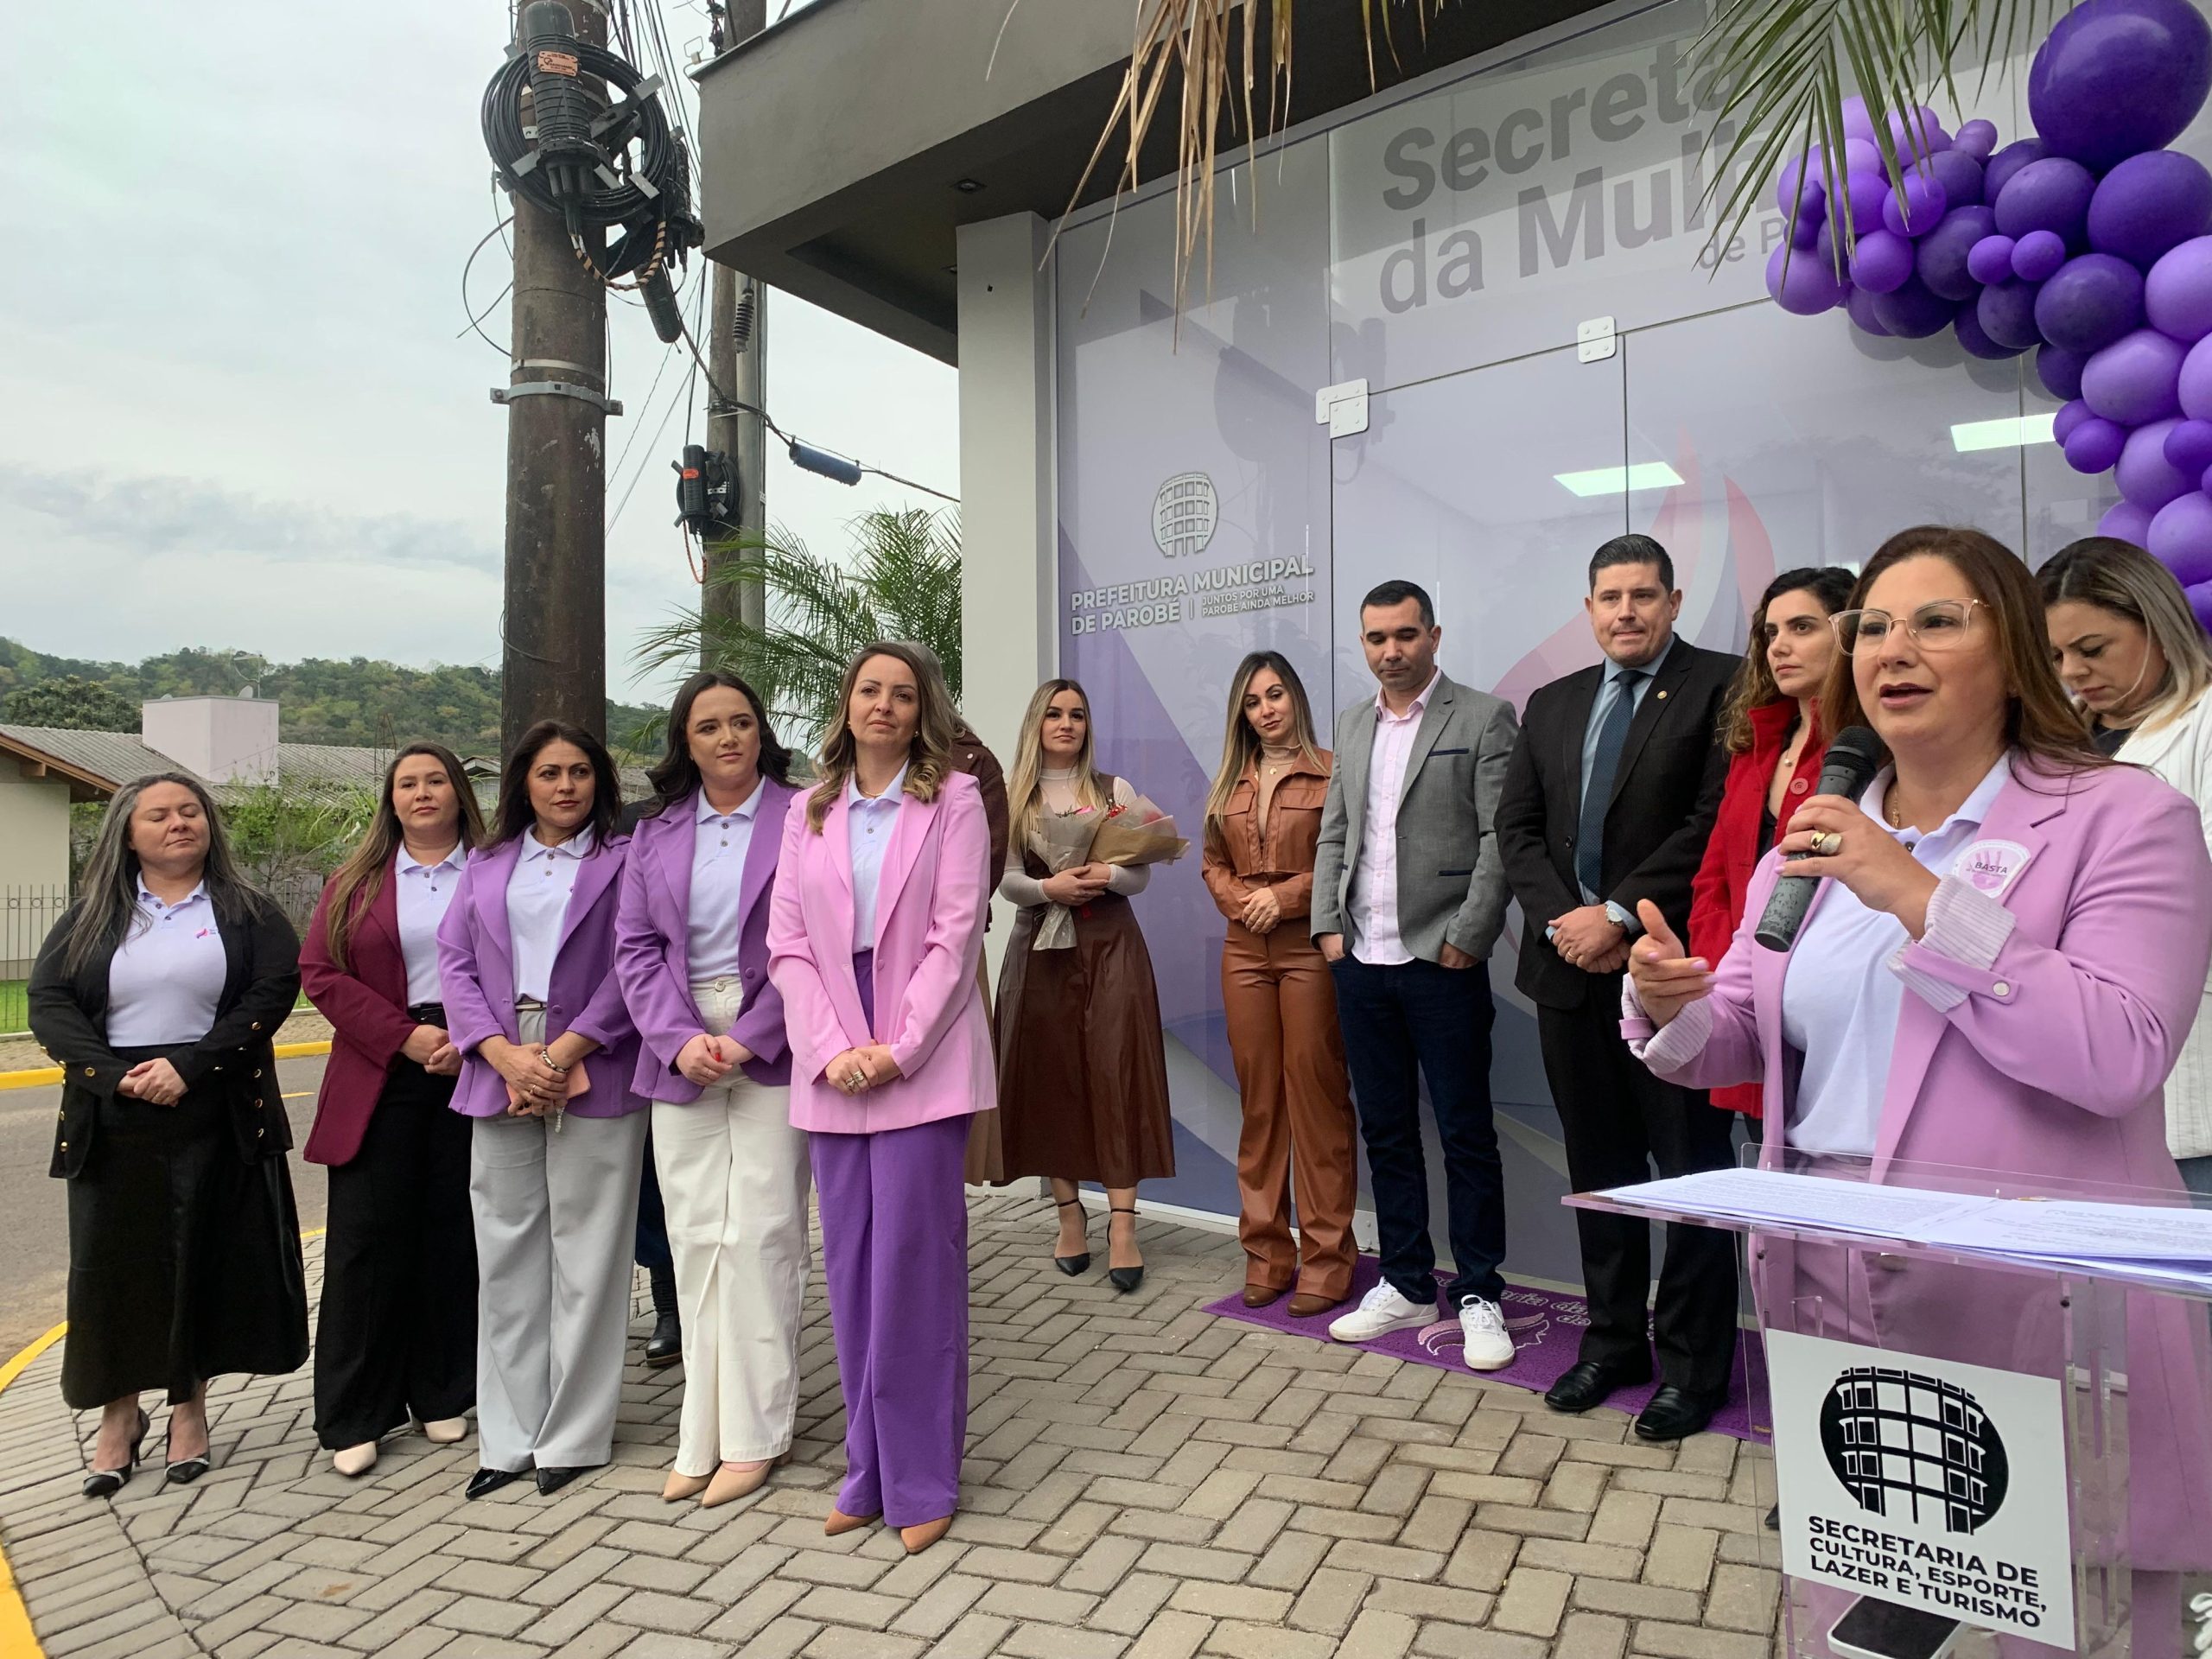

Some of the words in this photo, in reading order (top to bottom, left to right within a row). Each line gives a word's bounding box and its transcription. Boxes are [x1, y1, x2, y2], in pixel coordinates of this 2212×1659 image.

[1380, 218, 1484, 314] da
[1699, 230, 1745, 269] de
[1071, 575, 1188, 611] PREFEITURA
[1193, 554, 1314, 592] MUNICIPAL
[1202, 592, 1237, 606] JUNTOS
[1240, 588, 1259, 600] POR
[1262, 585, 1284, 596] UMA
[1202, 601, 1238, 617] PAROBÉ
[1241, 598, 1270, 611] AINDA
[1273, 591, 1314, 606] MELHOR
[1071, 614, 1096, 635] DE
[1102, 597, 1180, 631] PAROBÉ
[1974, 861, 2007, 874] BASTA
[1808, 1516, 1987, 1575] SECRETARIA
[1996, 1560, 2039, 1588] DE
[1809, 1537, 1920, 1580] CULTURA,
[1928, 1567, 2047, 1612] ESPORTE,
[1811, 1554, 1889, 1589] LAZER
[1897, 1577, 1911, 1594] E
[1918, 1582, 2040, 1628] TURISMO
